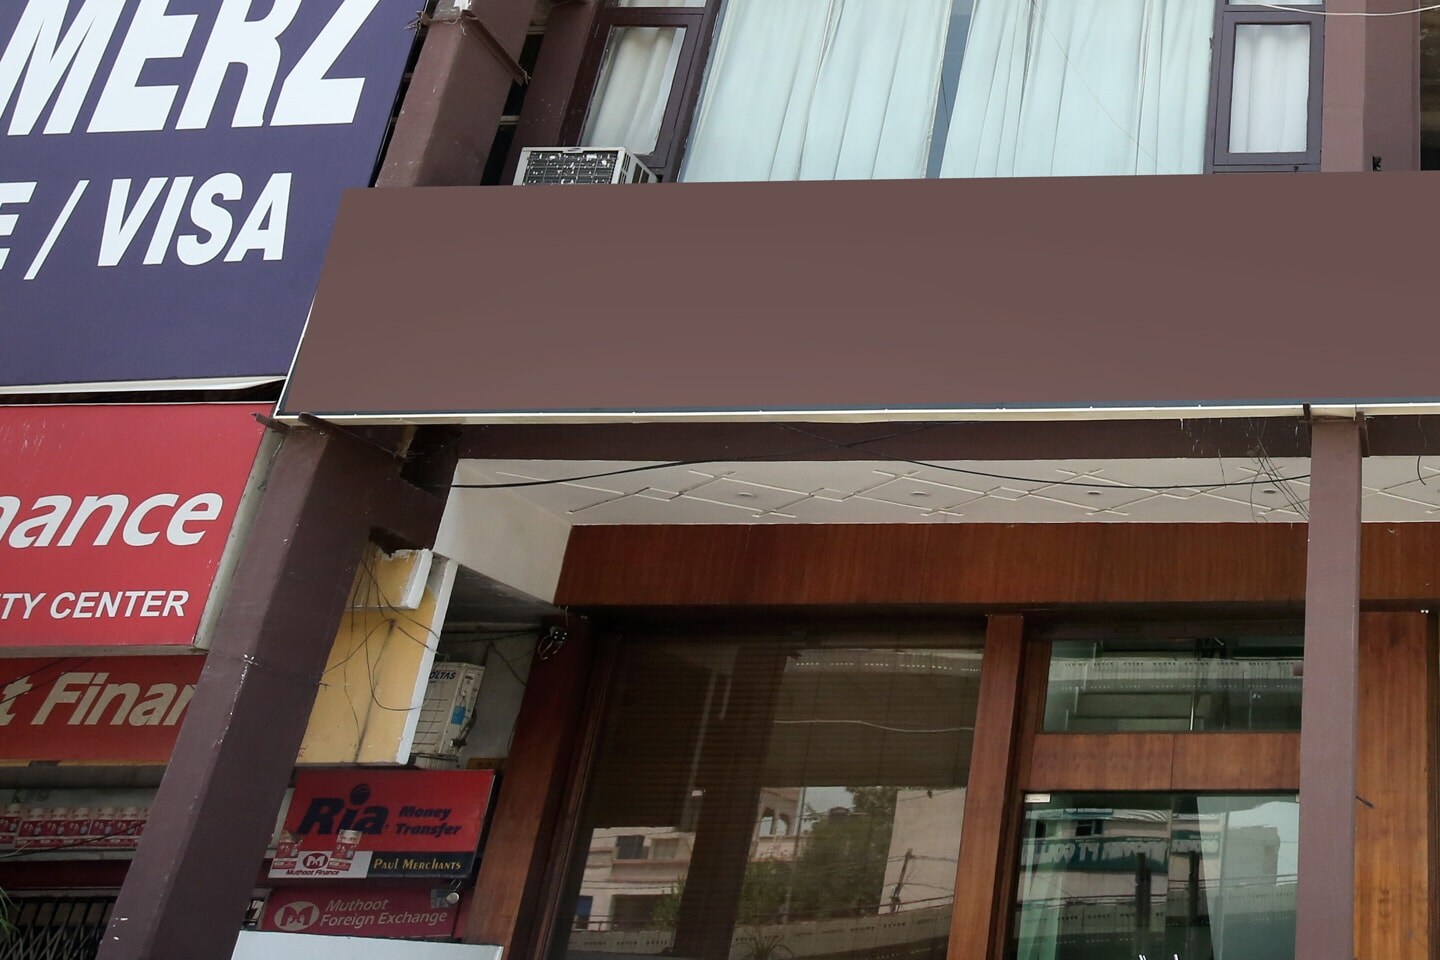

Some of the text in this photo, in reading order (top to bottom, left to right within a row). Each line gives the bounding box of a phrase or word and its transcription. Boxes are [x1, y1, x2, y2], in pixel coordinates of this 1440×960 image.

[98, 171, 292, 268] VISA
[50, 590, 189, 619] CENTER
[298, 784, 389, 836] Ria
[398, 806, 451, 821] Money
[396, 822, 462, 838] Transfer
[326, 898, 389, 912] Muthoot
[320, 912, 448, 928] Foreign Exchange
